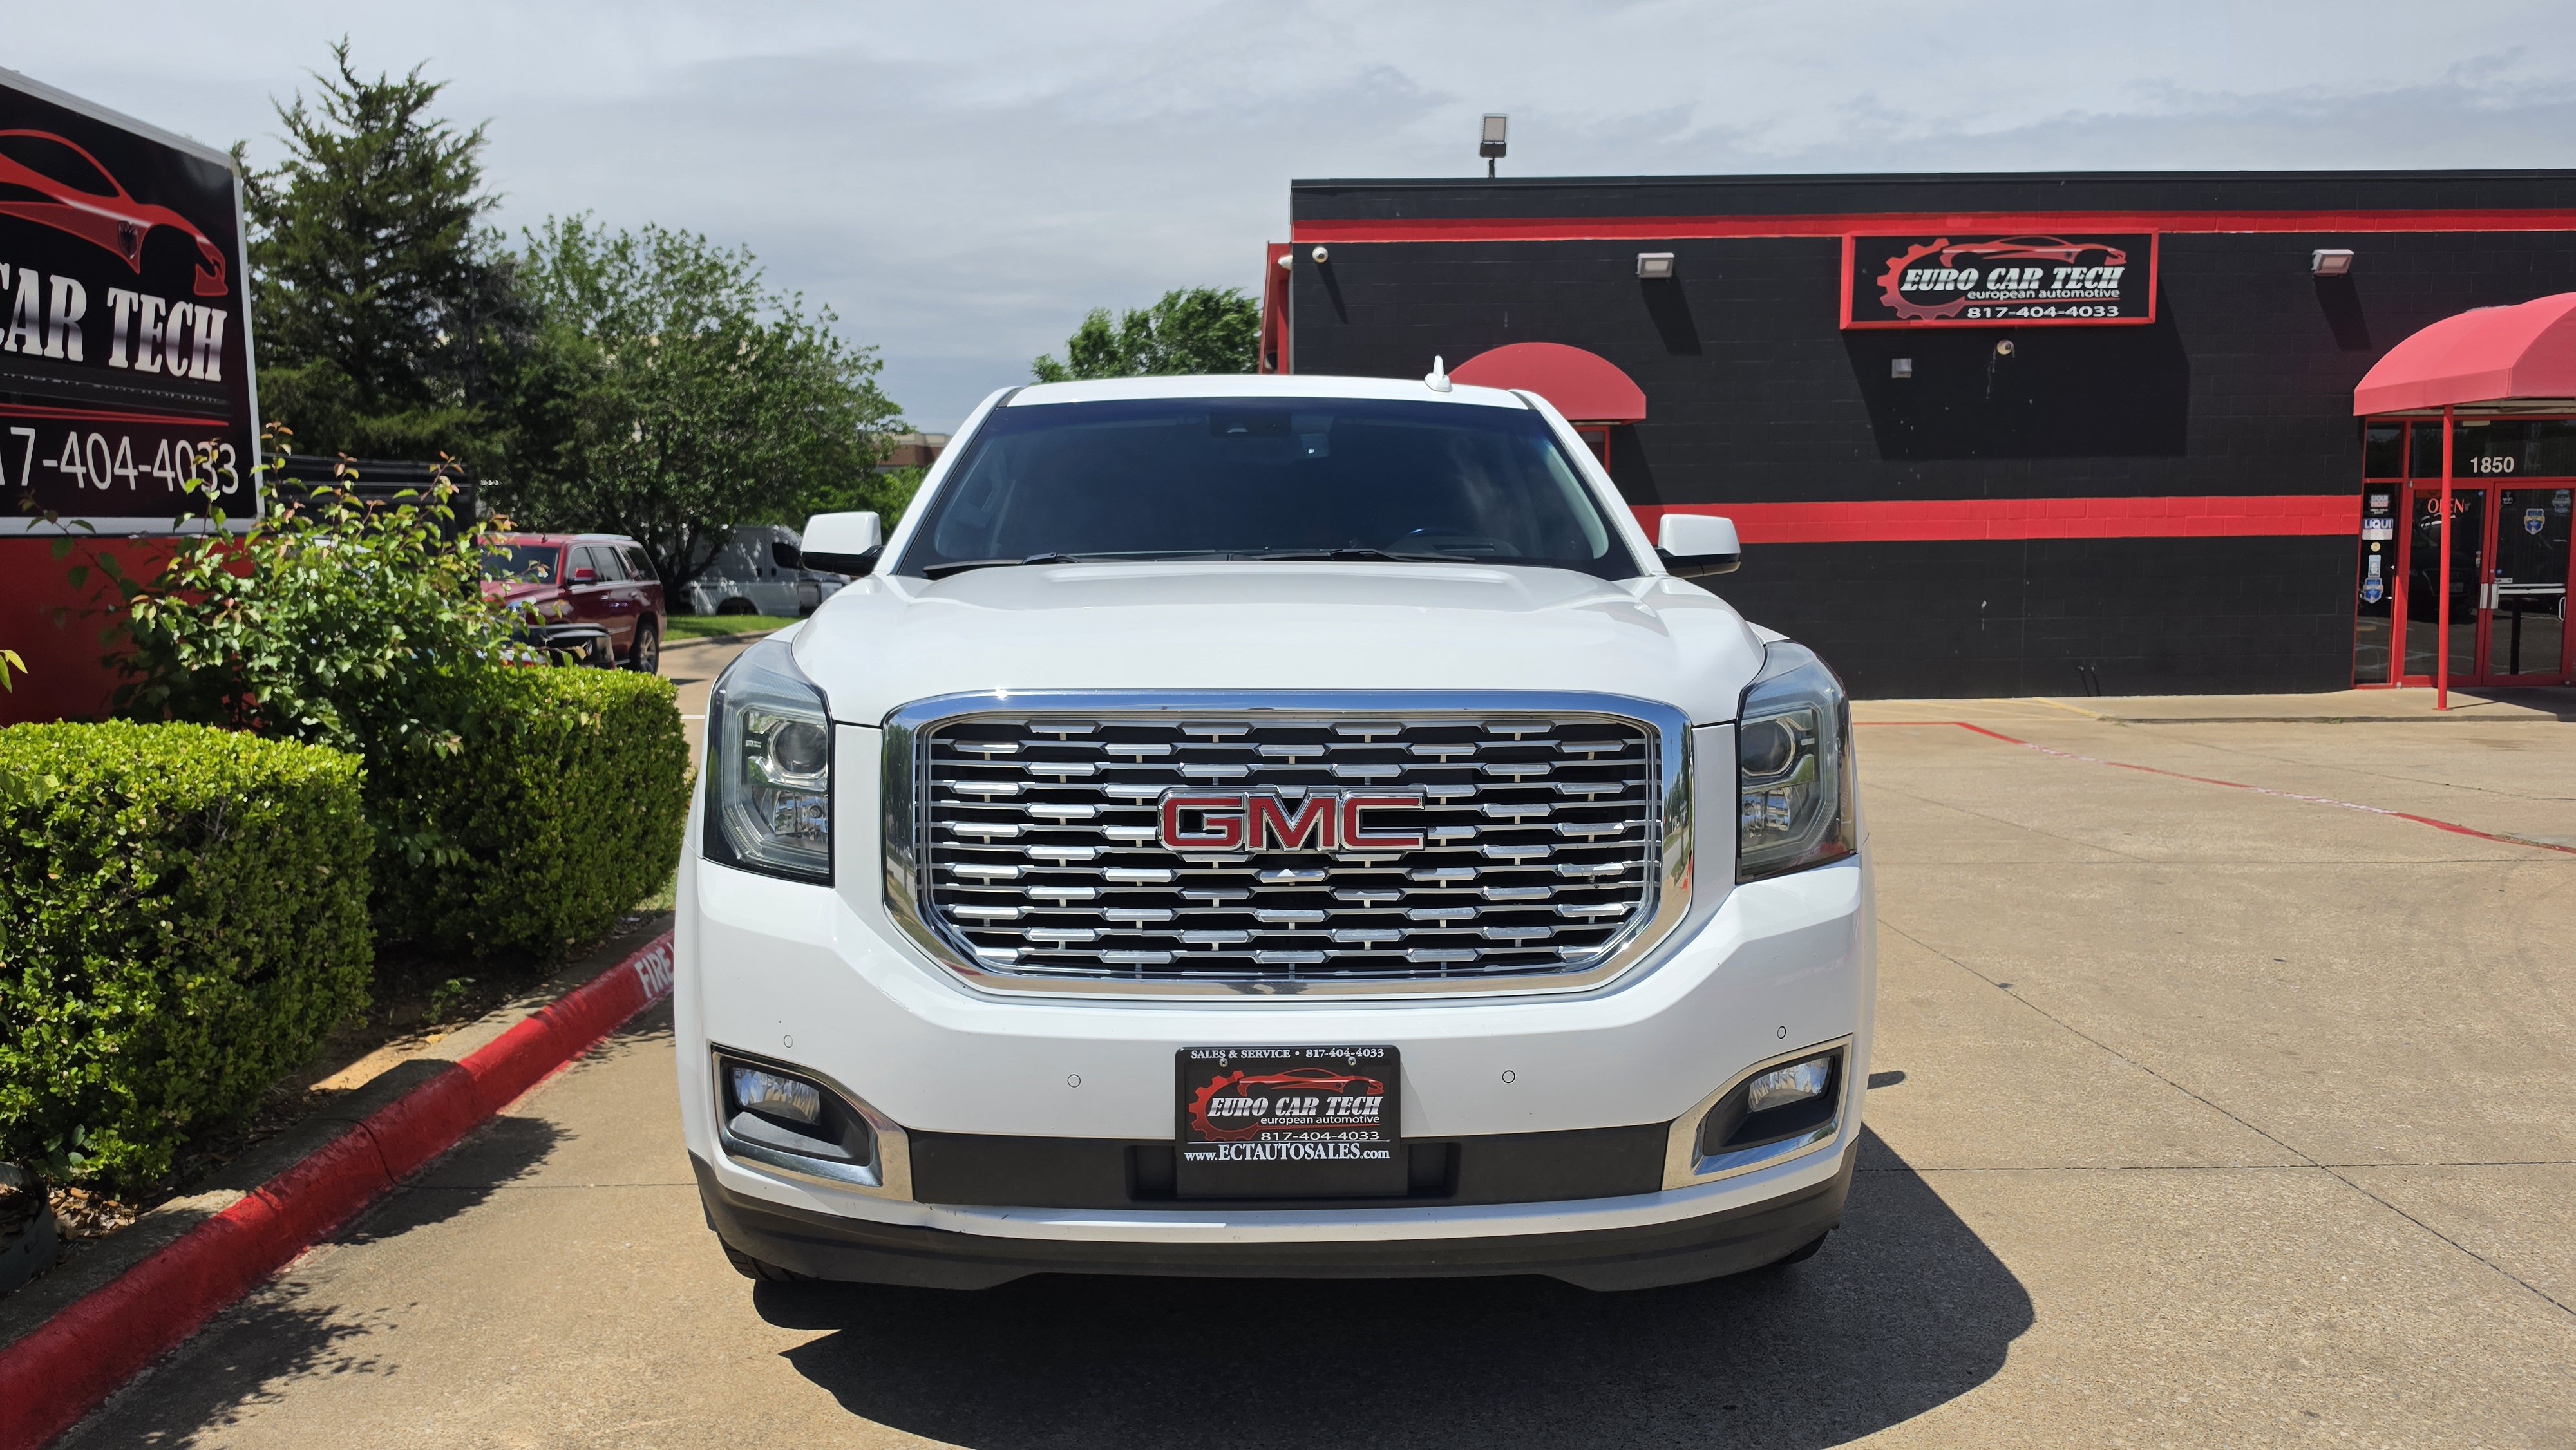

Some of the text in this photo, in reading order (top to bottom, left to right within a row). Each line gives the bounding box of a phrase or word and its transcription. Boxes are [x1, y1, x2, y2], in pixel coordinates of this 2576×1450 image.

[1900, 266, 2126, 292] EURO CAR TECH
[1967, 287, 2121, 301] european automotive
[1967, 305, 2120, 319] 817-404-4033
[0, 262, 228, 382] AR TECH
[0, 426, 239, 495] 7-404-4033
[2470, 456, 2515, 474] 1850
[2364, 519, 2392, 530] LIQUI
[1158, 785, 1428, 851] GMC
[634, 946, 674, 999] FIRE
[1191, 1048, 1385, 1059] SALES & SERVICE 817-404-4033
[1208, 1096, 1383, 1117] EURO CAR TECH
[1260, 1115, 1380, 1126] european automotive
[1260, 1131, 1379, 1141] 817-404-4033
[1184, 1142, 1390, 1161] www.ECTAUTOSALES.com
